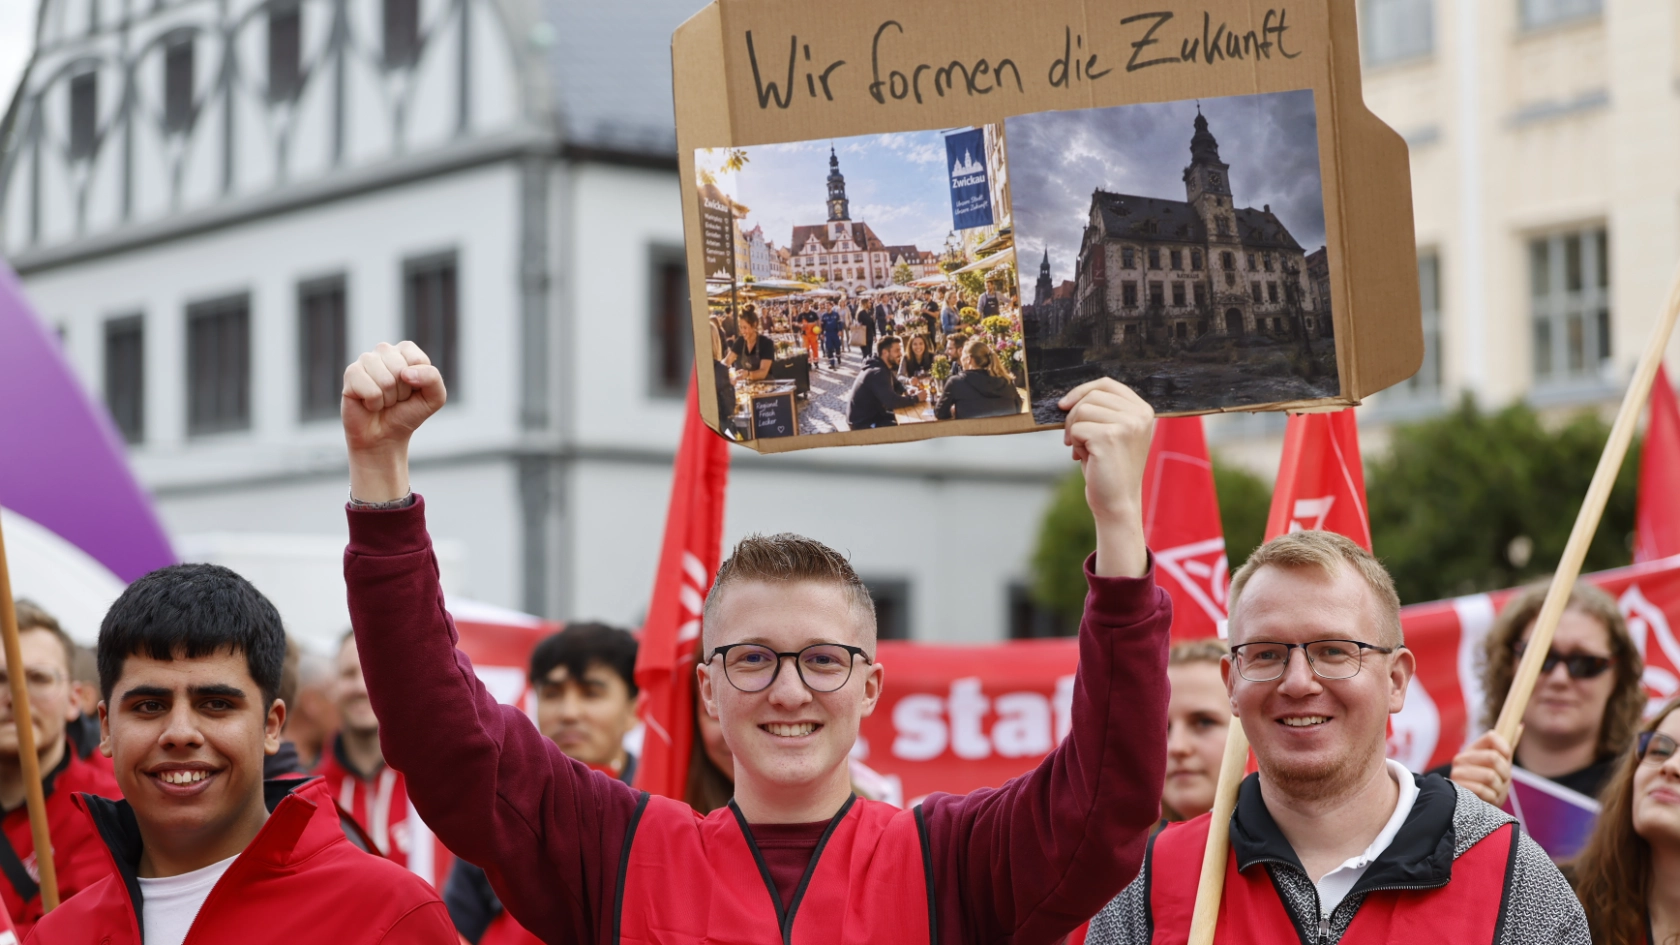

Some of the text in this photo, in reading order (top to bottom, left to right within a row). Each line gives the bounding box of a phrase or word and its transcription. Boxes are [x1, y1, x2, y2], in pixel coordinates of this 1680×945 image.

[745, 8, 1302, 109] Wir formen die Zukunft
[952, 175, 985, 188] Zwickau
[704, 197, 728, 212] Zwickau
[756, 399, 778, 410] Regional
[759, 409, 775, 418] Frisch
[758, 418, 777, 426] Lecker
